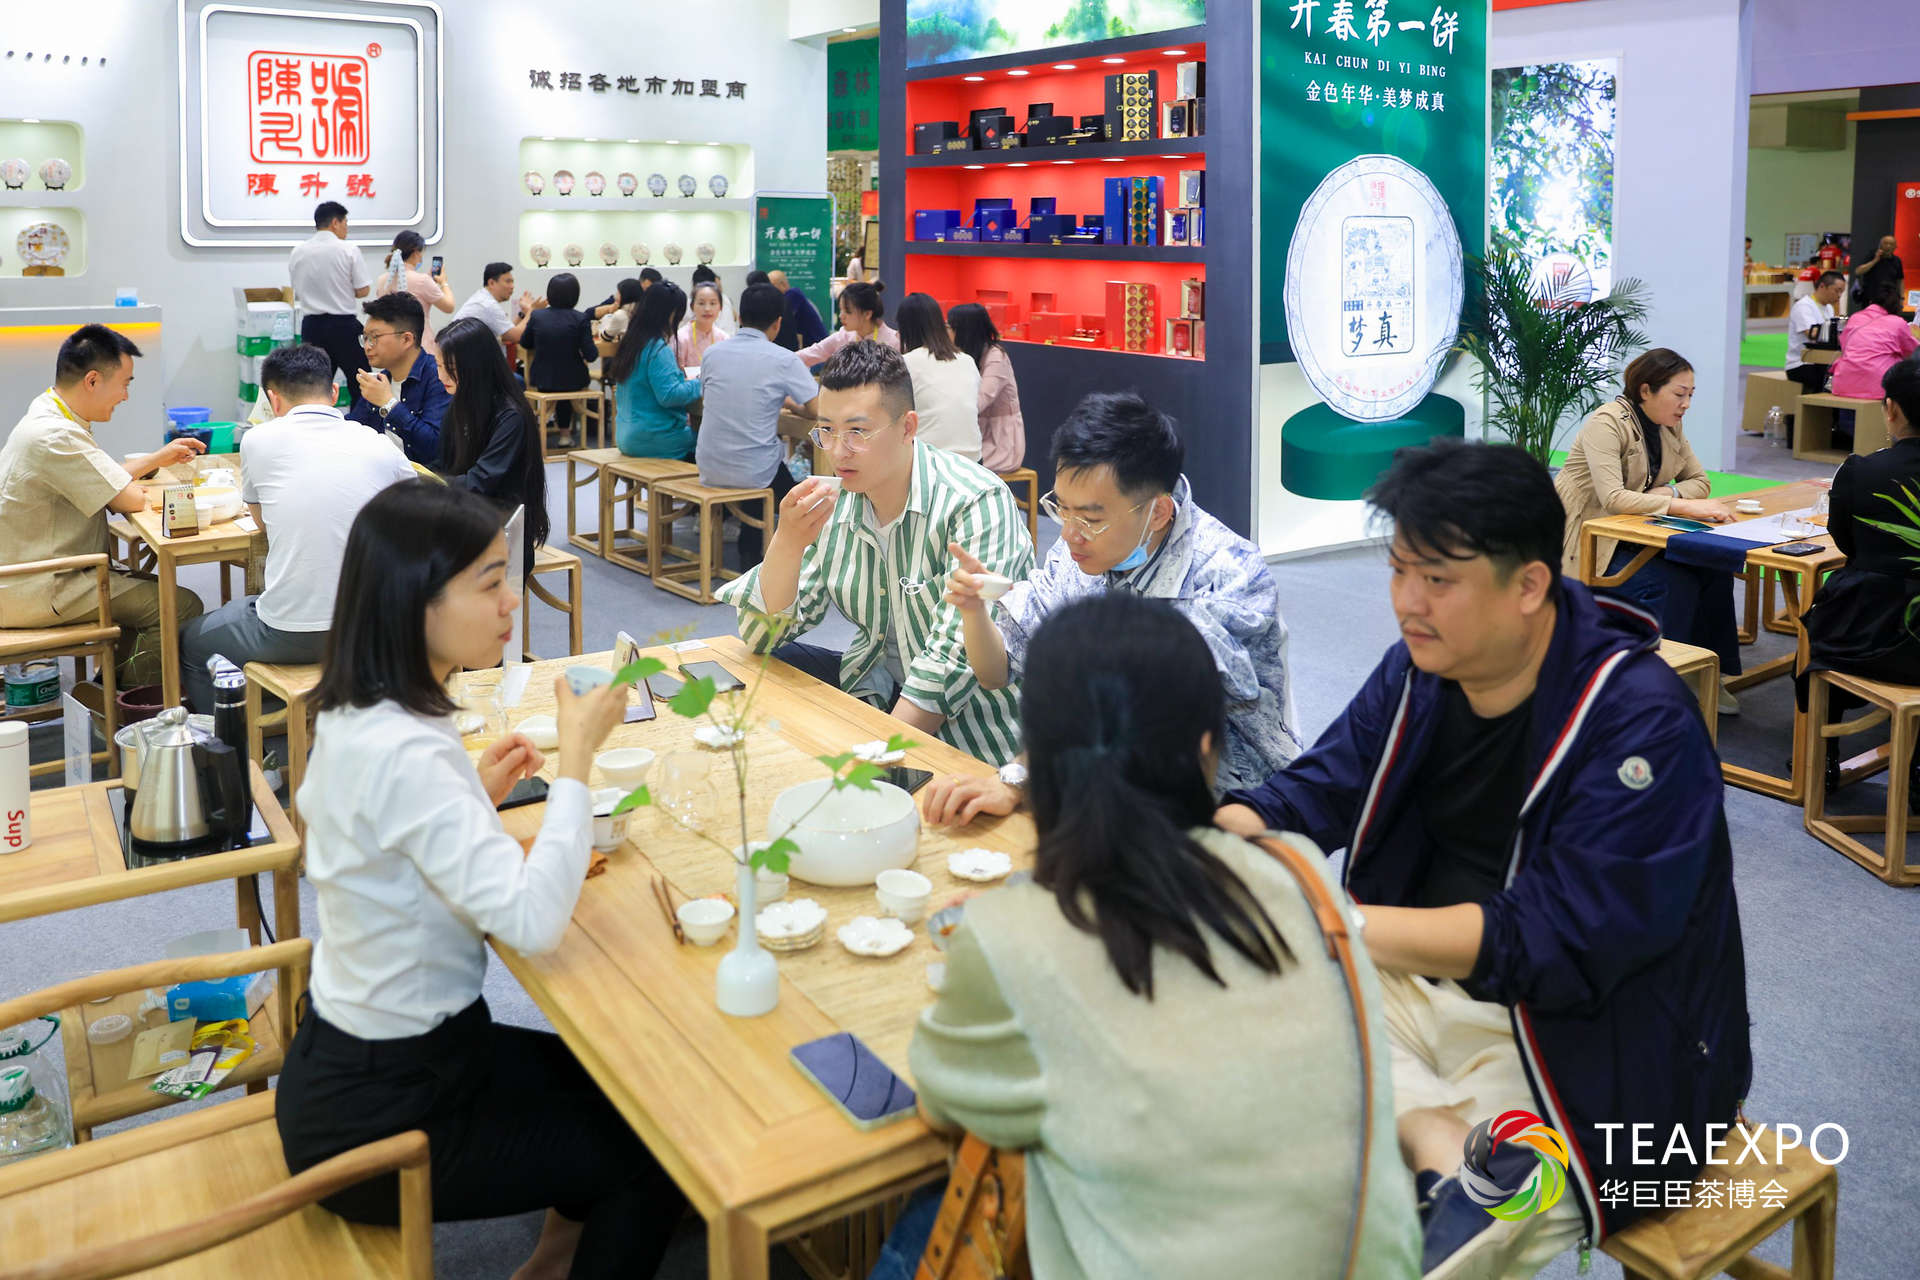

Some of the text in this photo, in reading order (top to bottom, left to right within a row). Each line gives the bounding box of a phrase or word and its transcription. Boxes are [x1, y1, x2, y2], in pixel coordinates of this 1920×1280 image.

[1289, 0, 1460, 55] 开春第一饼
[1304, 51, 1447, 78] KAI CHUN DI YI BING
[529, 69, 748, 100] 诚招各地市加盟商
[247, 171, 377, 199] 陳升號
[3, 808, 25, 848] Sup
